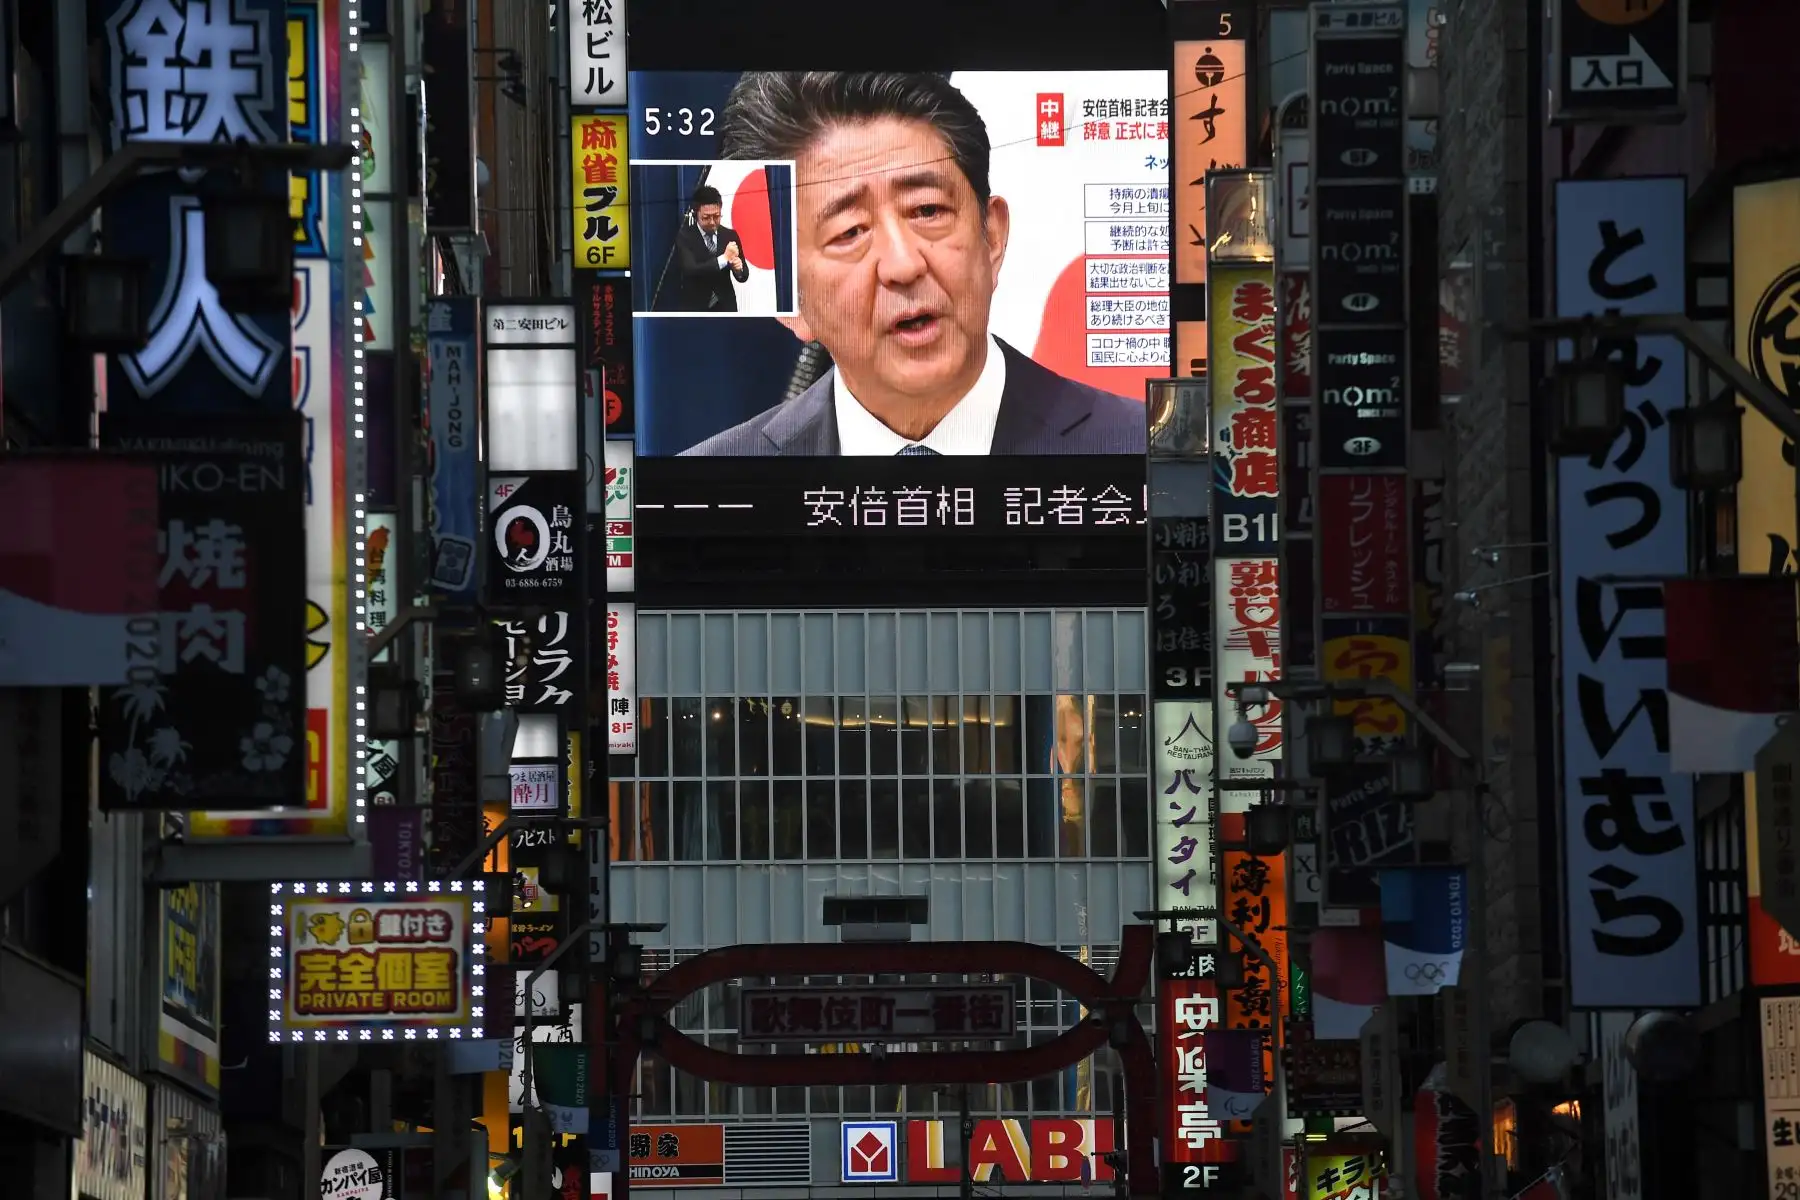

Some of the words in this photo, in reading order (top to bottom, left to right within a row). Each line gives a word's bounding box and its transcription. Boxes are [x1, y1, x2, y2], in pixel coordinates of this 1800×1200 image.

[1219, 13, 1232, 36] 5
[583, 0, 614, 95] 松ビル
[1582, 61, 1643, 87] 入口
[1083, 98, 1132, 118] 安倍首相
[1134, 98, 1169, 118] 記者会
[643, 106, 716, 137] 5:32
[1040, 99, 1060, 139] 中継
[1083, 121, 1111, 141] 辞意
[1115, 121, 1169, 141] 正式に表
[581, 118, 619, 242] 麻雀ブル
[110, 0, 280, 395] 鉄人
[1109, 201, 1169, 215] 今月上旬に
[1109, 225, 1169, 238] 継続的な処
[586, 246, 615, 264] 6F
[1110, 239, 1169, 251] 予断は許さ
[1090, 263, 1169, 275] 大切な政治判断を
[1090, 277, 1169, 289] 結果出せないこと
[1090, 300, 1168, 312] 総理大臣の地位
[493, 317, 570, 331] 第二安田ビル
[1090, 314, 1170, 326] あり続けるべき
[1091, 337, 1161, 349] コロナ禍の中
[1354, 440, 1372, 452] 3F
[496, 484, 514, 498] 4F
[802, 484, 976, 527] 安倍首相
[1003, 484, 1148, 527] 記者会
[1348, 476, 1375, 610] リフレッシュ
[545, 556, 574, 572] 酒場
[157, 518, 247, 675] 焼肉
[533, 611, 574, 705] リラク
[1165, 667, 1212, 688] 3F
[611, 722, 633, 734] 8F
[529, 769, 555, 783] 居酒屋
[513, 783, 549, 804] 酔月
[1164, 768, 1202, 896] バンタイ
[397, 822, 414, 869] TOKYO
[1449, 874, 1462, 922] TOKYO
[1451, 923, 1464, 949] 2020
[299, 952, 451, 991] 完全個室
[300, 992, 385, 1009] PRIVATE
[393, 991, 450, 1007] ROOM
[576, 1053, 586, 1082] TOKYO
[575, 1083, 586, 1105] 2020
[321, 1166, 384, 1194] カンパイ屋
[1183, 1165, 1220, 1188] 2F
